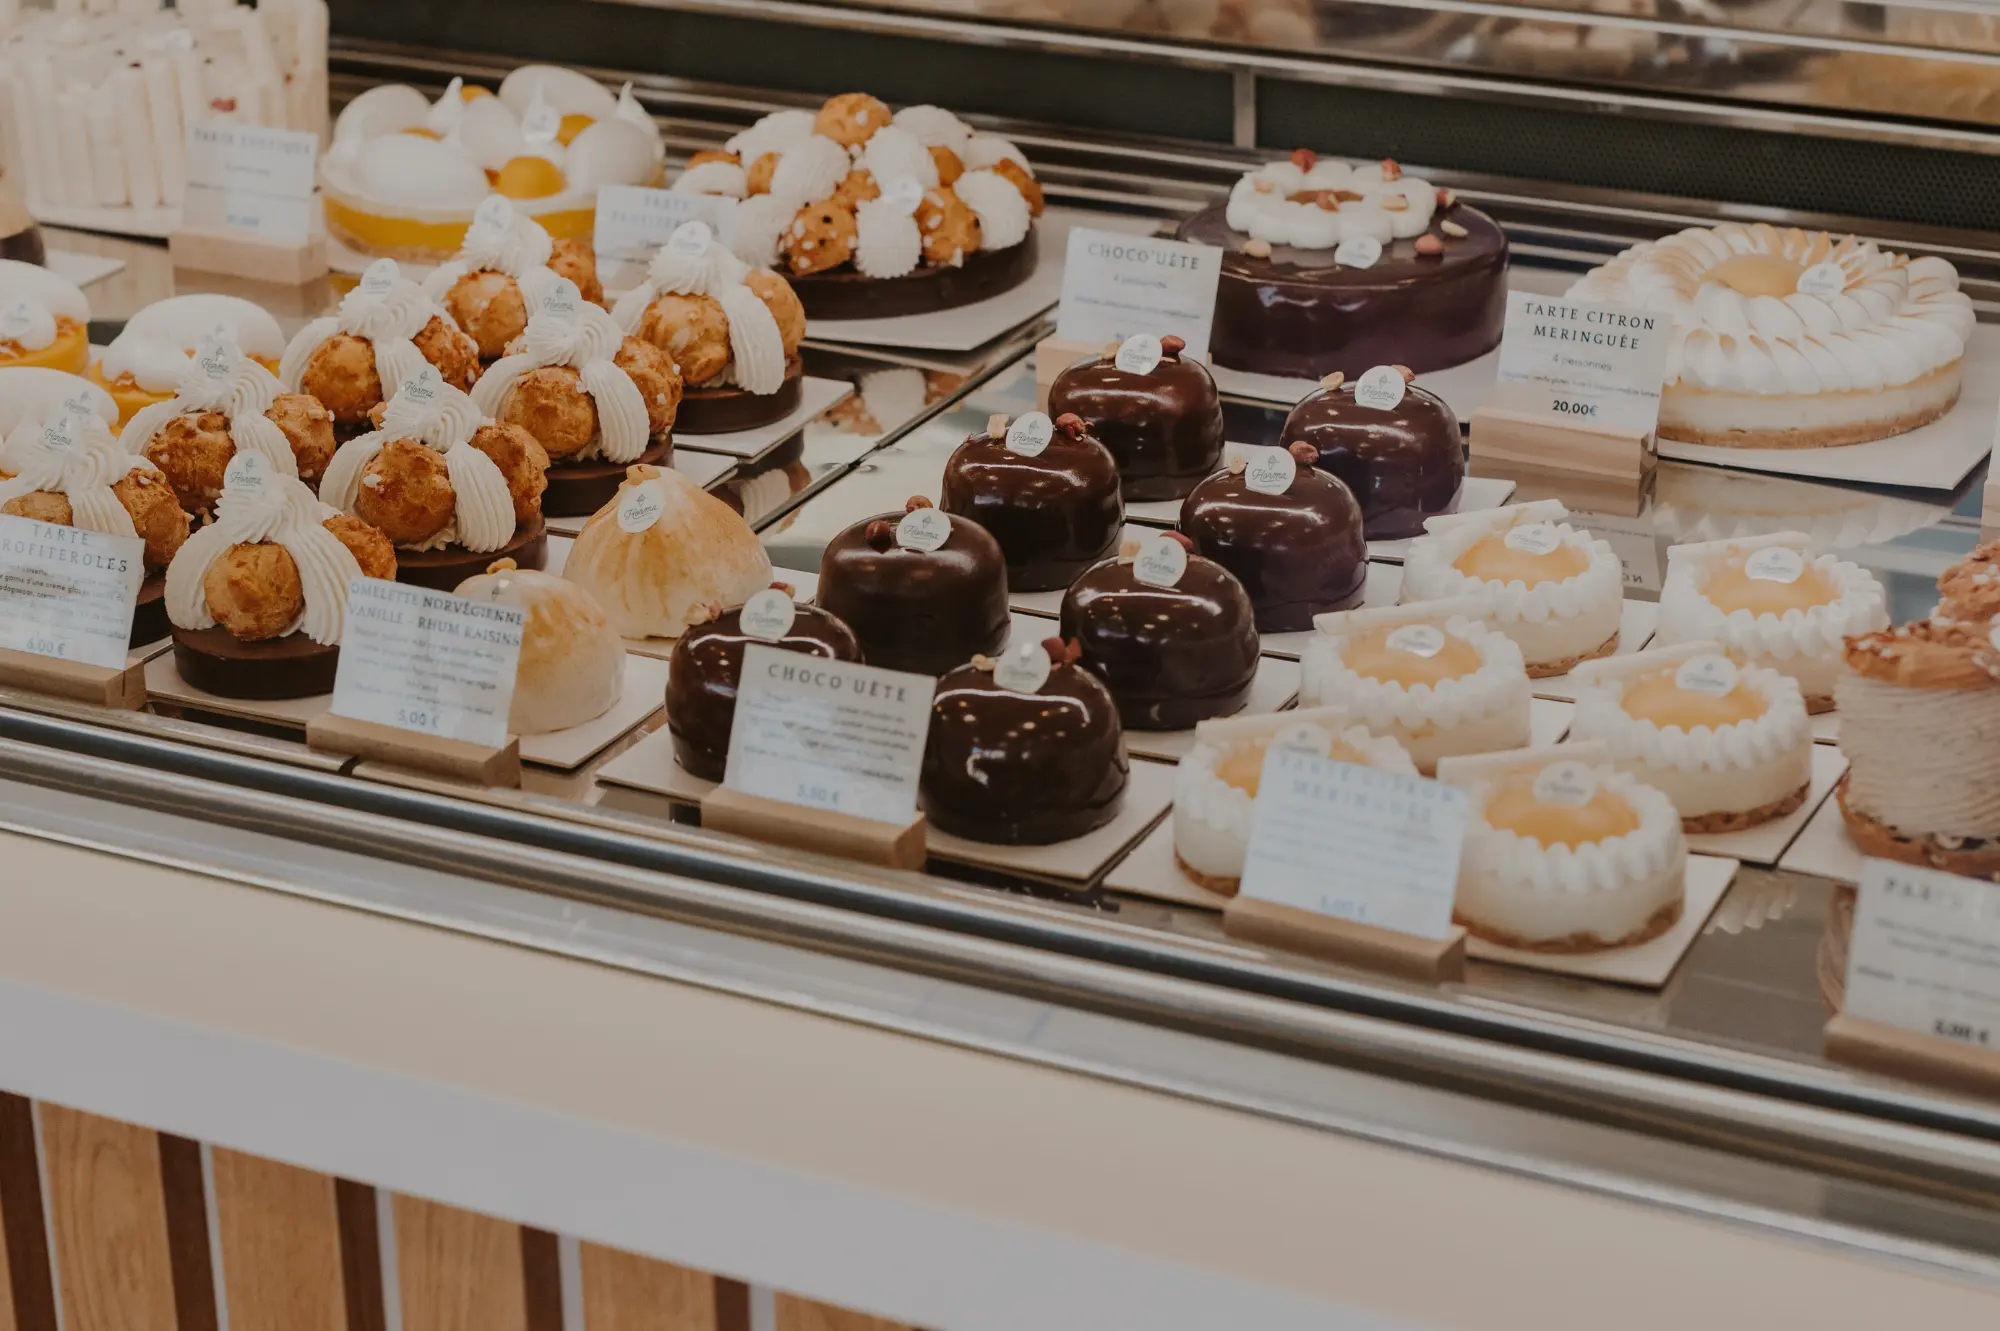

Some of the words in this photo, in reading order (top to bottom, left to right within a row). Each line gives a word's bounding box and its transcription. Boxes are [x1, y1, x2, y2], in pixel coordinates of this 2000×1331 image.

[1524, 302, 1579, 320] TARTE
[1586, 310, 1655, 331] CITRON
[1533, 325, 1640, 350] MERINGUÉE
[1552, 352, 1559, 363] 4
[1561, 357, 1613, 372] personnes
[32, 524, 90, 546] TARTE
[351, 583, 419, 606] OMELETTE
[349, 603, 404, 625] VANILLE
[417, 616, 460, 634] RHUM
[464, 626, 521, 646] RAISINS
